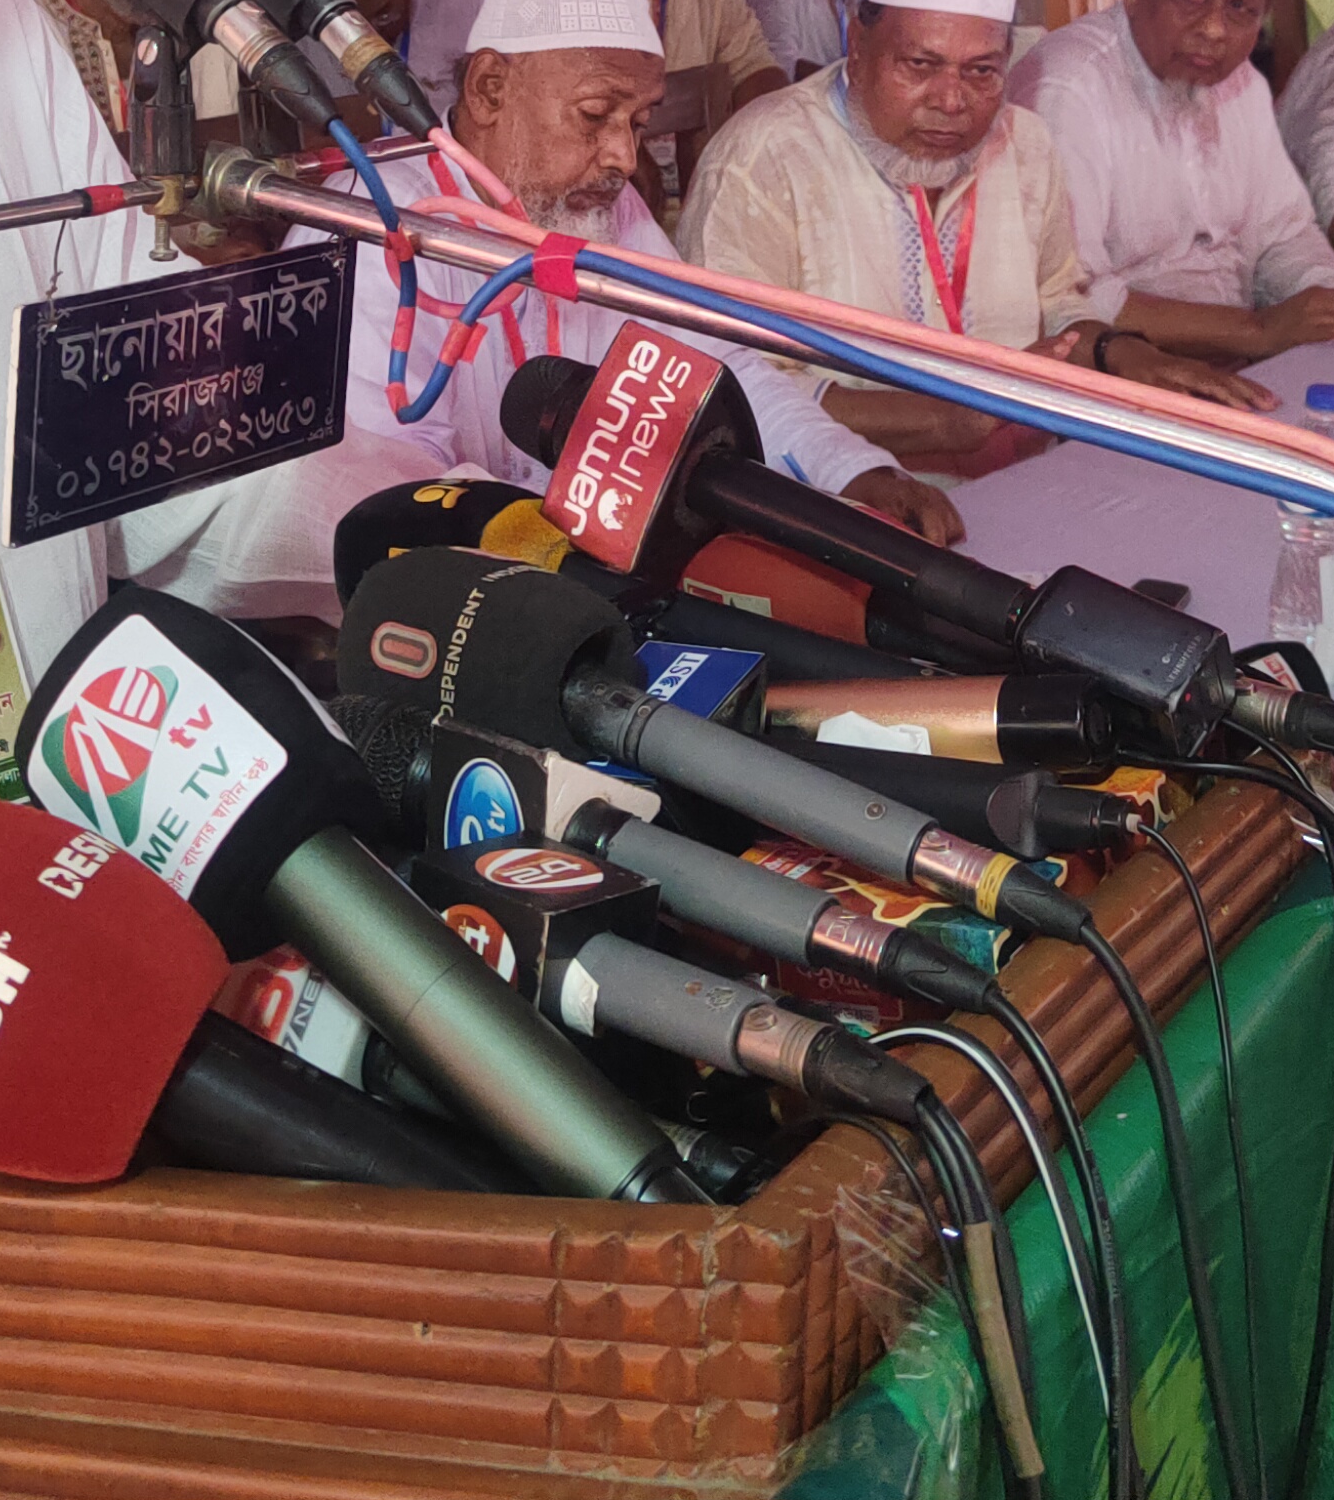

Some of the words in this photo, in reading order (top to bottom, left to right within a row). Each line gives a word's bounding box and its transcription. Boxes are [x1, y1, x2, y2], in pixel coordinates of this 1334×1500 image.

[57, 300, 227, 391] ছানোয়ার
[238, 269, 331, 341] মাইক
[125, 362, 266, 429] সিরাজগঞ্জ
[56, 396, 316, 499] ০১৭৪২-০২২৬৫৩
[168, 703, 214, 750] tv
[179, 746, 230, 800] TV
[487, 798, 506, 834] tv
[182, 820, 217, 866] বাংলার
[501, 857, 583, 885] 24
